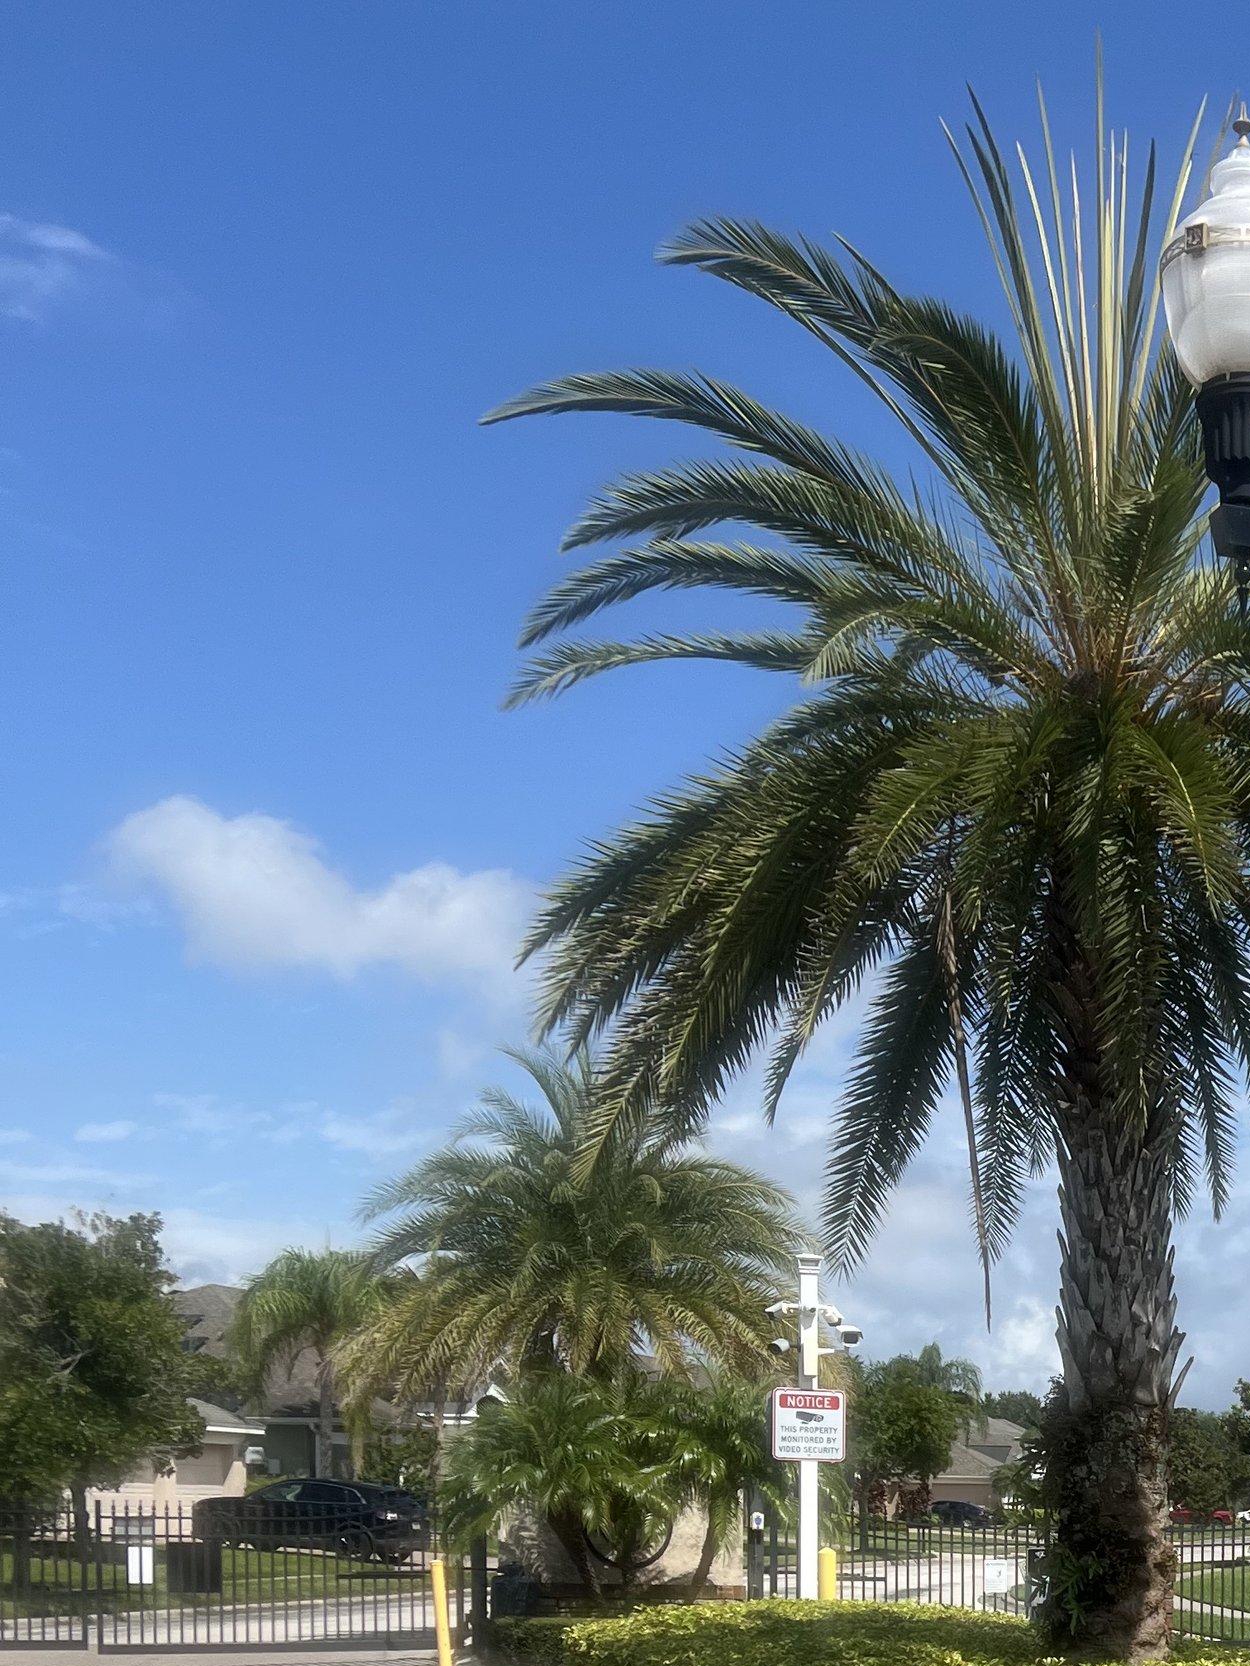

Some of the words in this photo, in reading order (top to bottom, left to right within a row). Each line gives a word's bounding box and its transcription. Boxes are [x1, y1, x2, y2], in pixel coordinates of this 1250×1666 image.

[787, 1396, 832, 1408] NOTICE
[780, 1425, 797, 1433] THIS
[799, 1426, 838, 1434] PROPERTY
[780, 1435, 824, 1444] MONITORED
[778, 1445, 801, 1453] VIDEO
[803, 1446, 840, 1454] SECURITY
